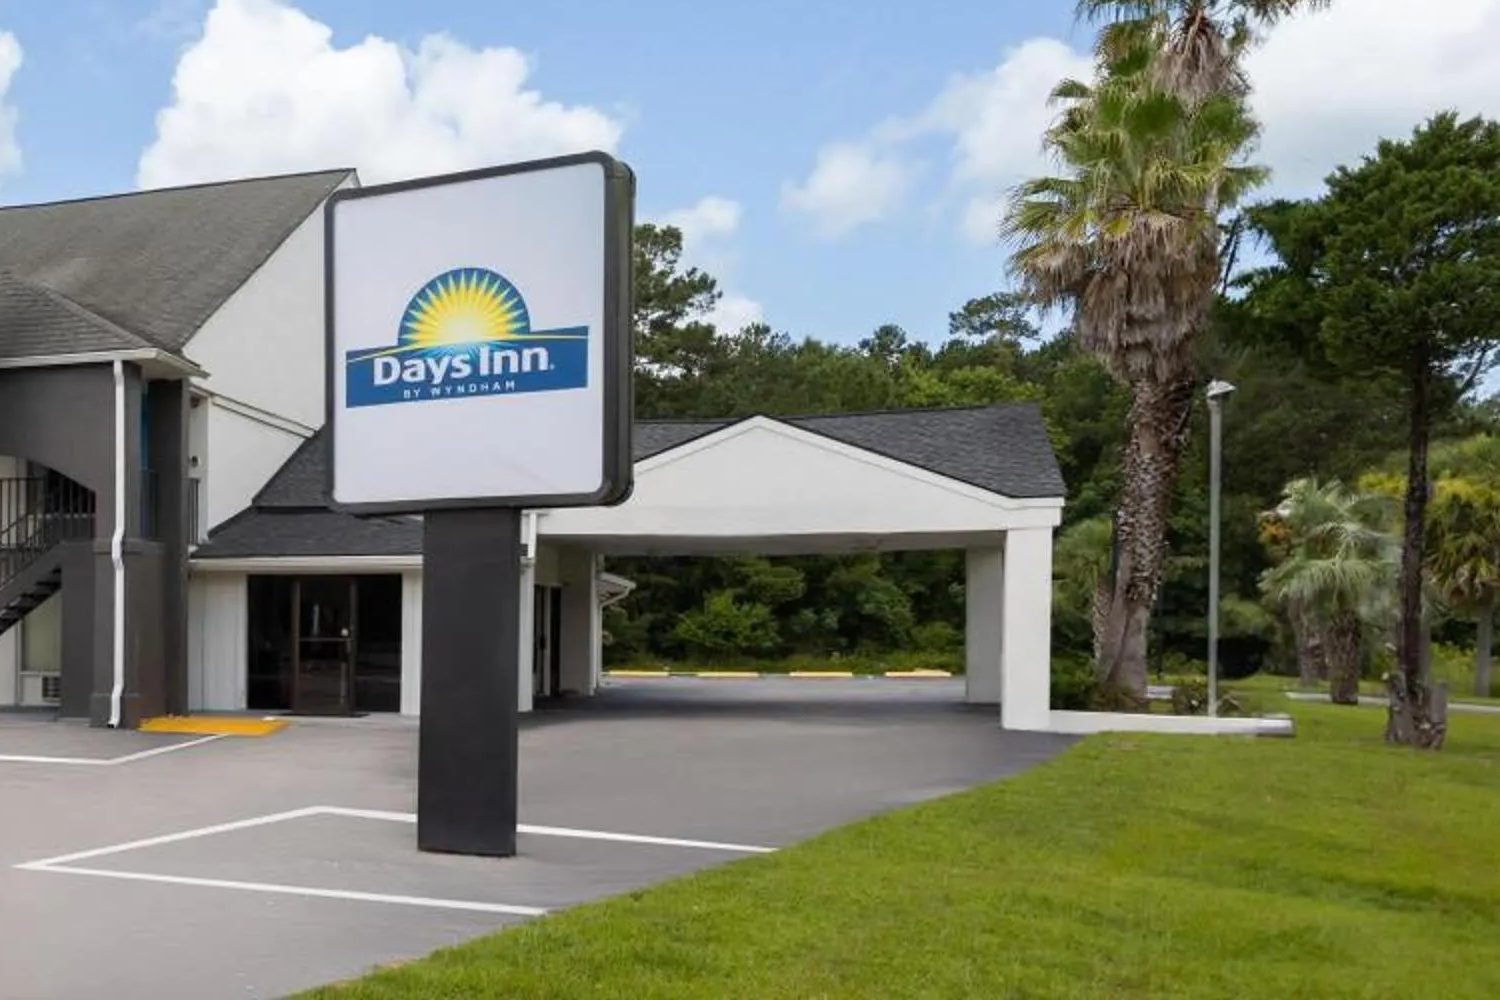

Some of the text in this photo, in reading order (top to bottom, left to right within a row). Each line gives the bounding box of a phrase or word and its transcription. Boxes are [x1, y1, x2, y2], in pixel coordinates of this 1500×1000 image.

[373, 347, 548, 385] Days Inn
[403, 381, 515, 399] BY WYNDHAM
